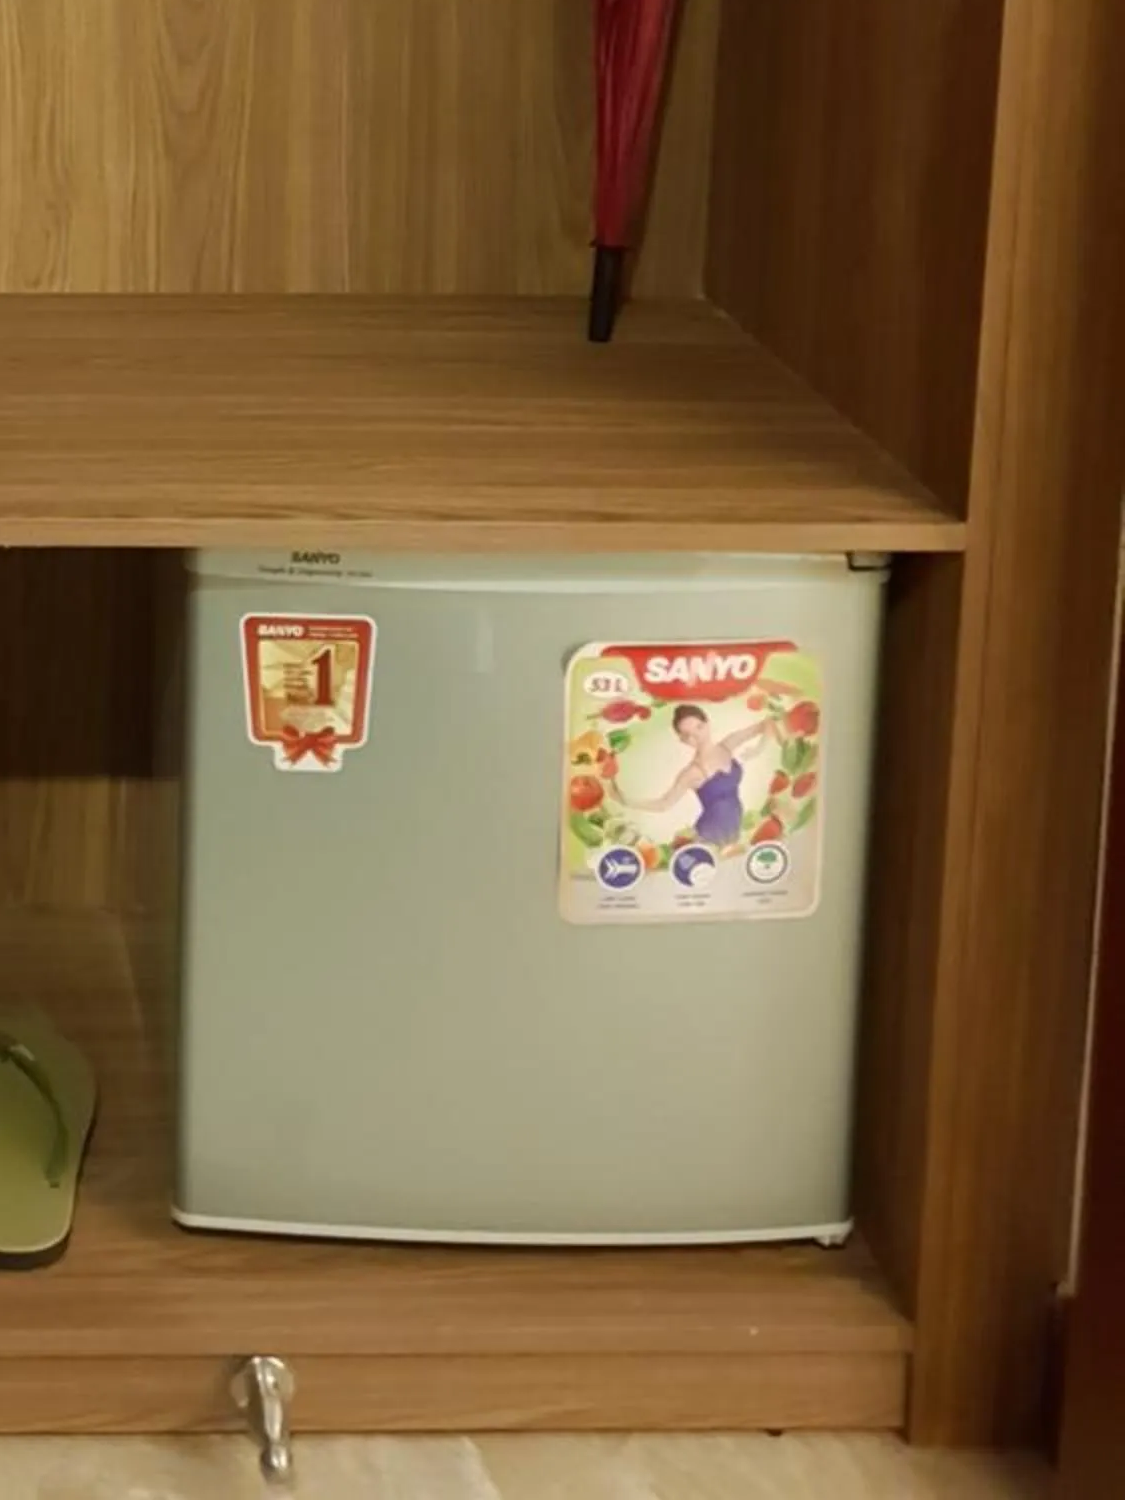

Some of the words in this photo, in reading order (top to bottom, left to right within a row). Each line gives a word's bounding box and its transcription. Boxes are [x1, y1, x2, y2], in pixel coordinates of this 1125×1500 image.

[291, 551, 341, 564] SANYO
[256, 624, 305, 637] SANYO
[311, 648, 336, 706] 1
[644, 652, 756, 685] SANYO
